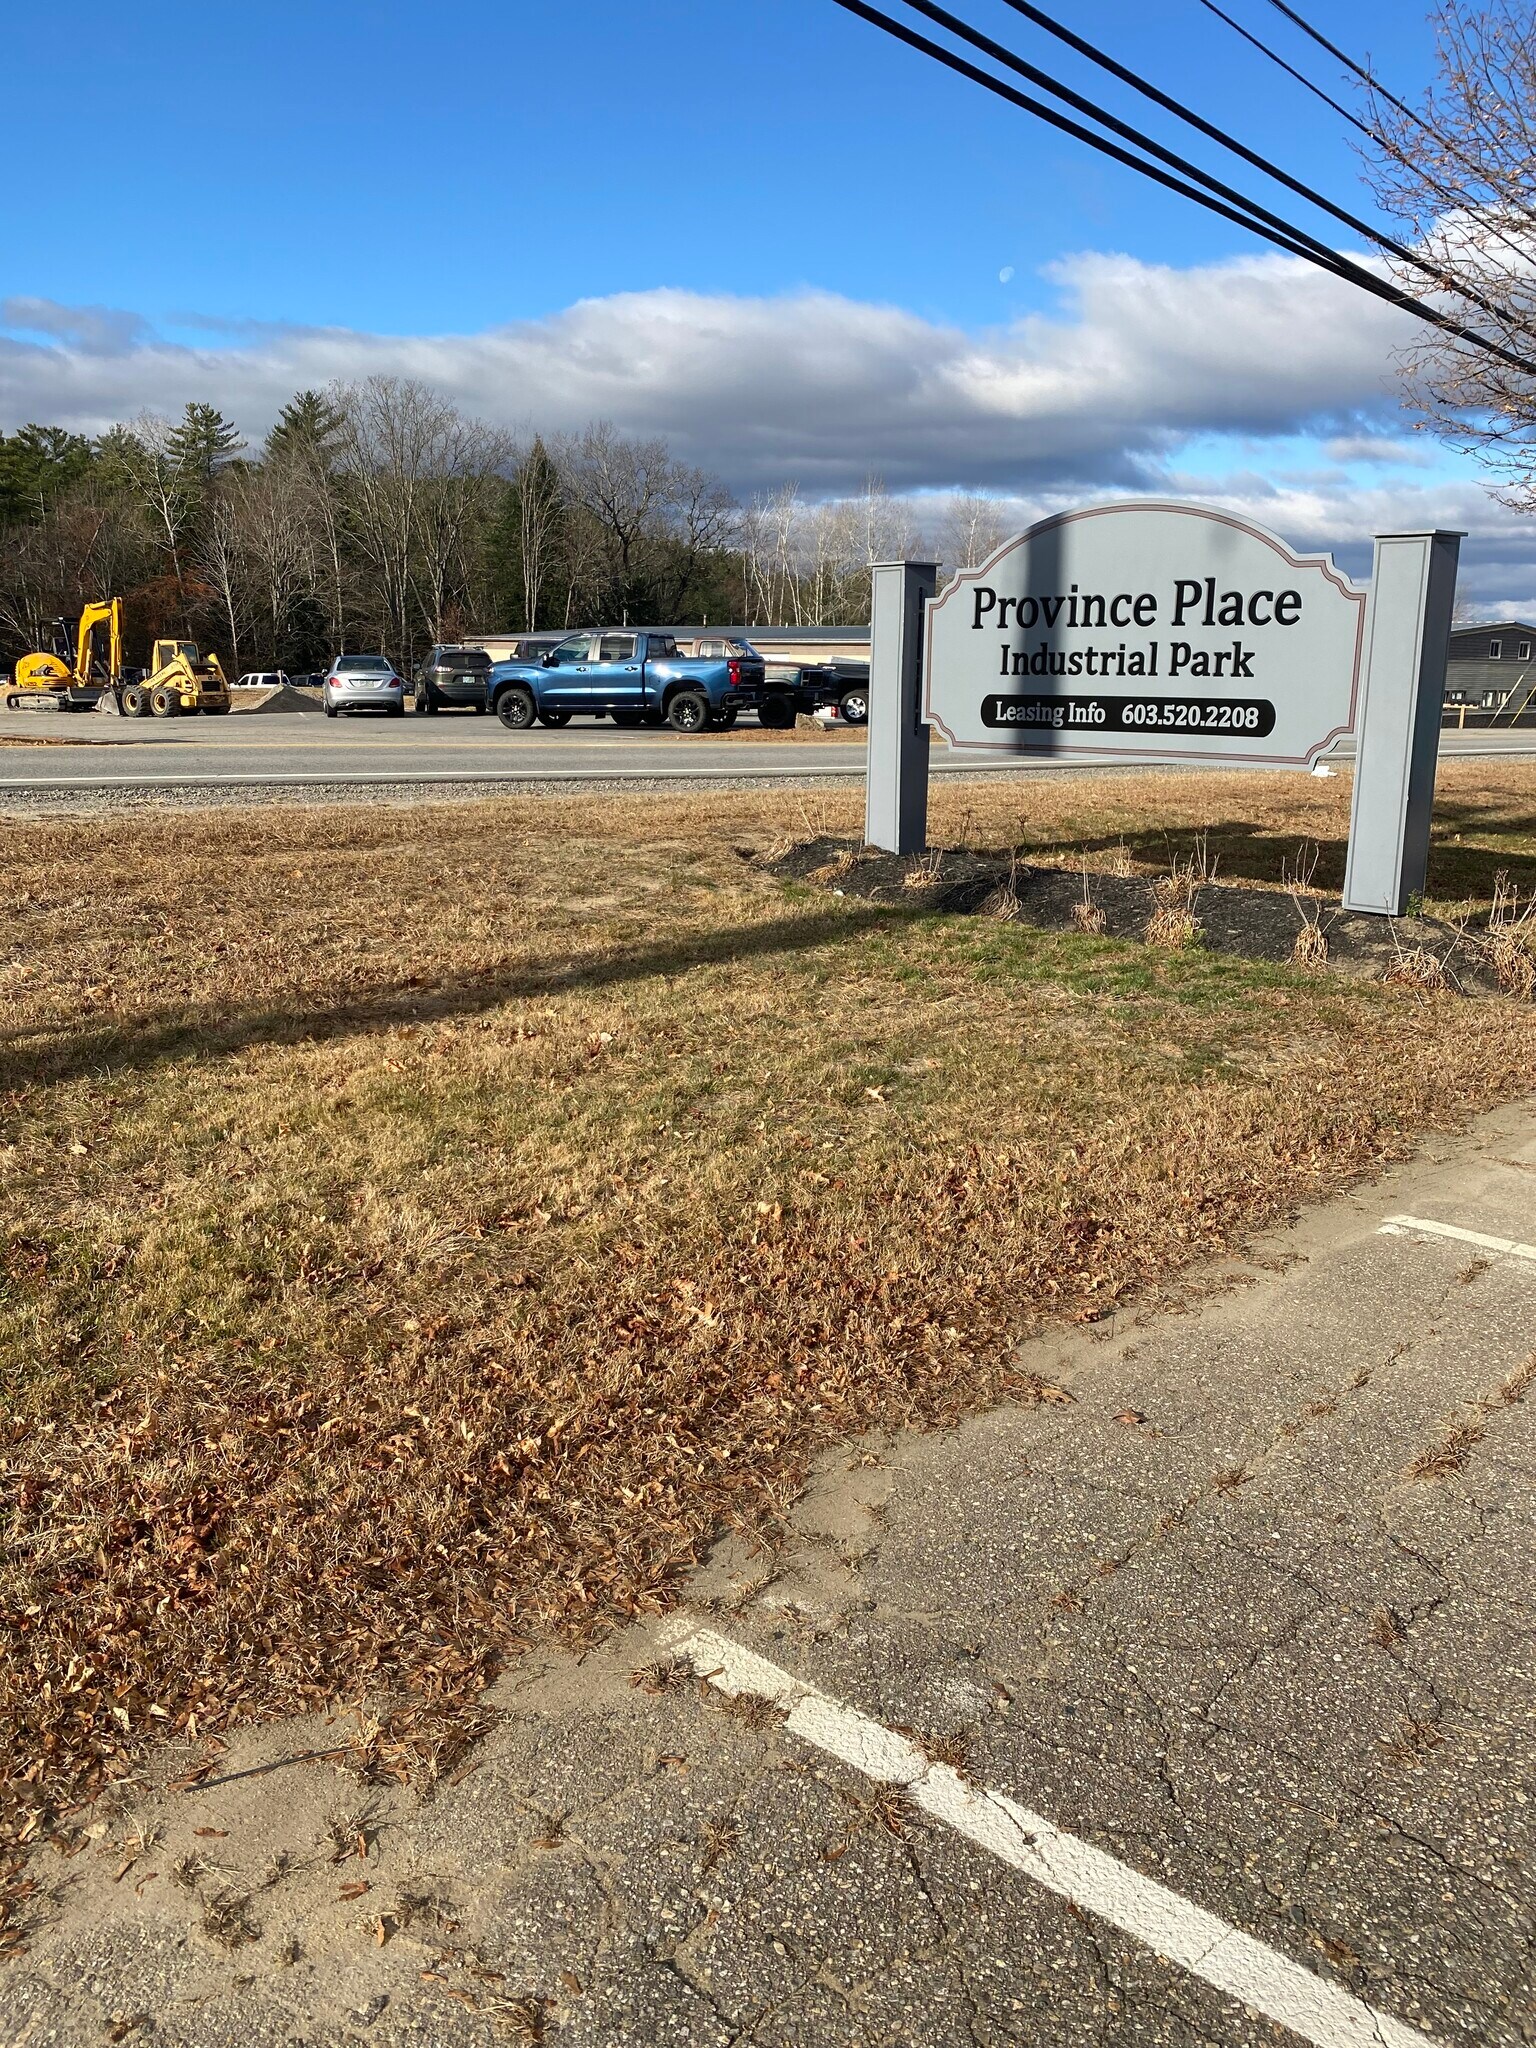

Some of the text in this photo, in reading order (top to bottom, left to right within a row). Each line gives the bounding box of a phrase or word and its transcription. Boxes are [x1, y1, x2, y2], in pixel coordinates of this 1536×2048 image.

[971, 577, 1302, 629] Province Place
[1000, 641, 1256, 677] Industrial Park
[995, 701, 1259, 728] Leasing Info 603.520.2208
